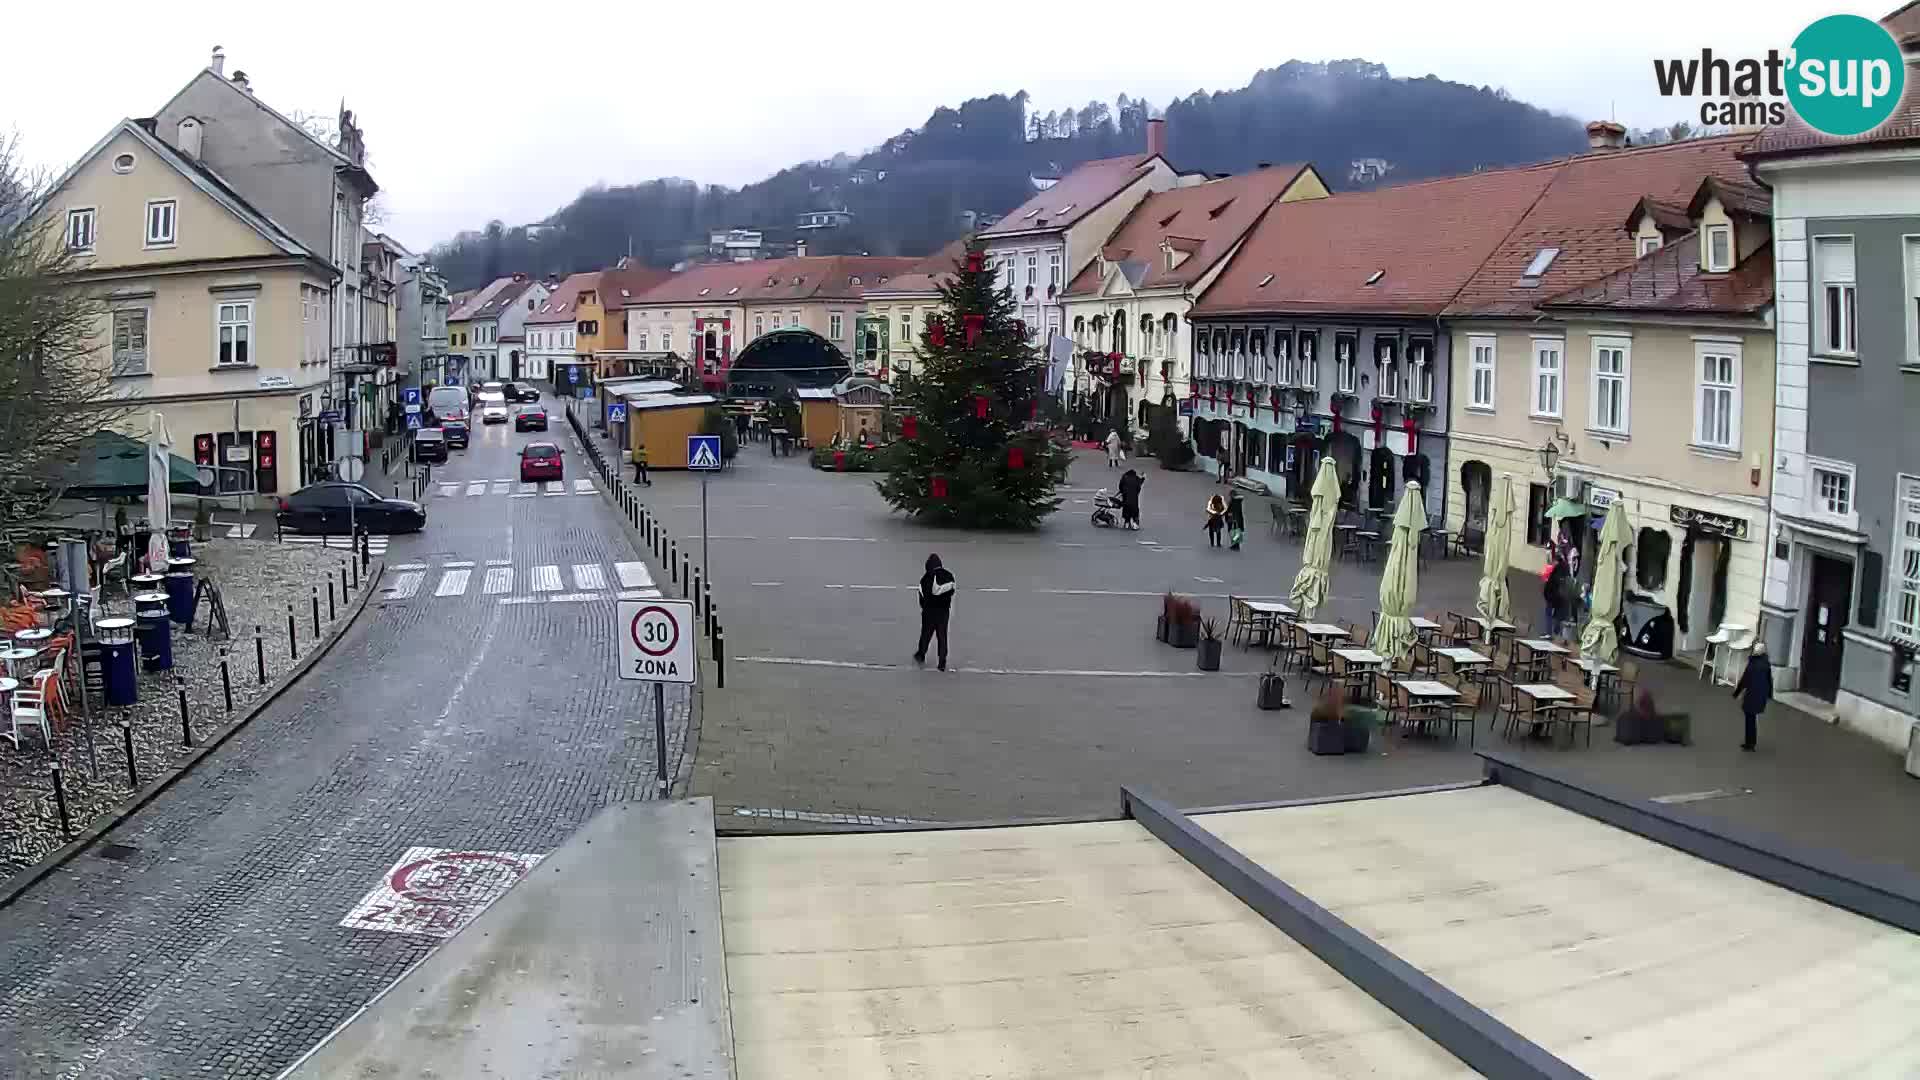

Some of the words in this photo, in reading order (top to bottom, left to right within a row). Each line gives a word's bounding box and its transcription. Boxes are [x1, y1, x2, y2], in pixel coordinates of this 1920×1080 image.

[408, 391, 416, 402] P
[644, 622, 668, 643] 30
[634, 659, 678, 676] ZONA
